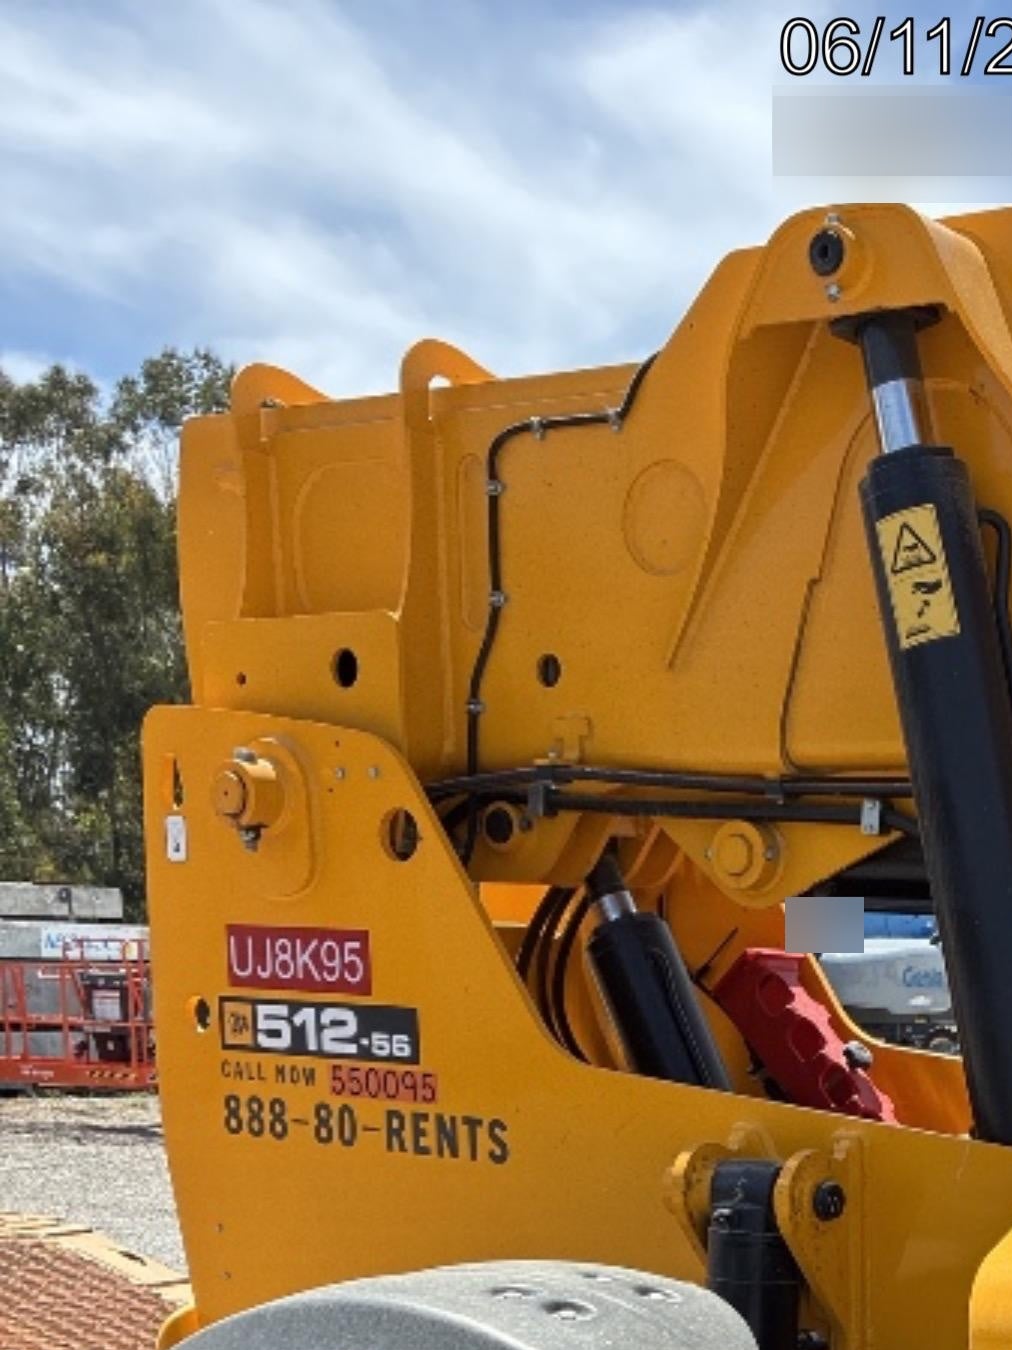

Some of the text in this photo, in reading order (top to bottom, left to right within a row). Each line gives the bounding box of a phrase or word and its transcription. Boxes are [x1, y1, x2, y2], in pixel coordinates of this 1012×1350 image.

[230, 935, 364, 984] UJ8K95
[221, 1059, 316, 1087] CALL NOW
[331, 1065, 437, 1102] 550095
[224, 1095, 510, 1165] 888-80-RENTS
